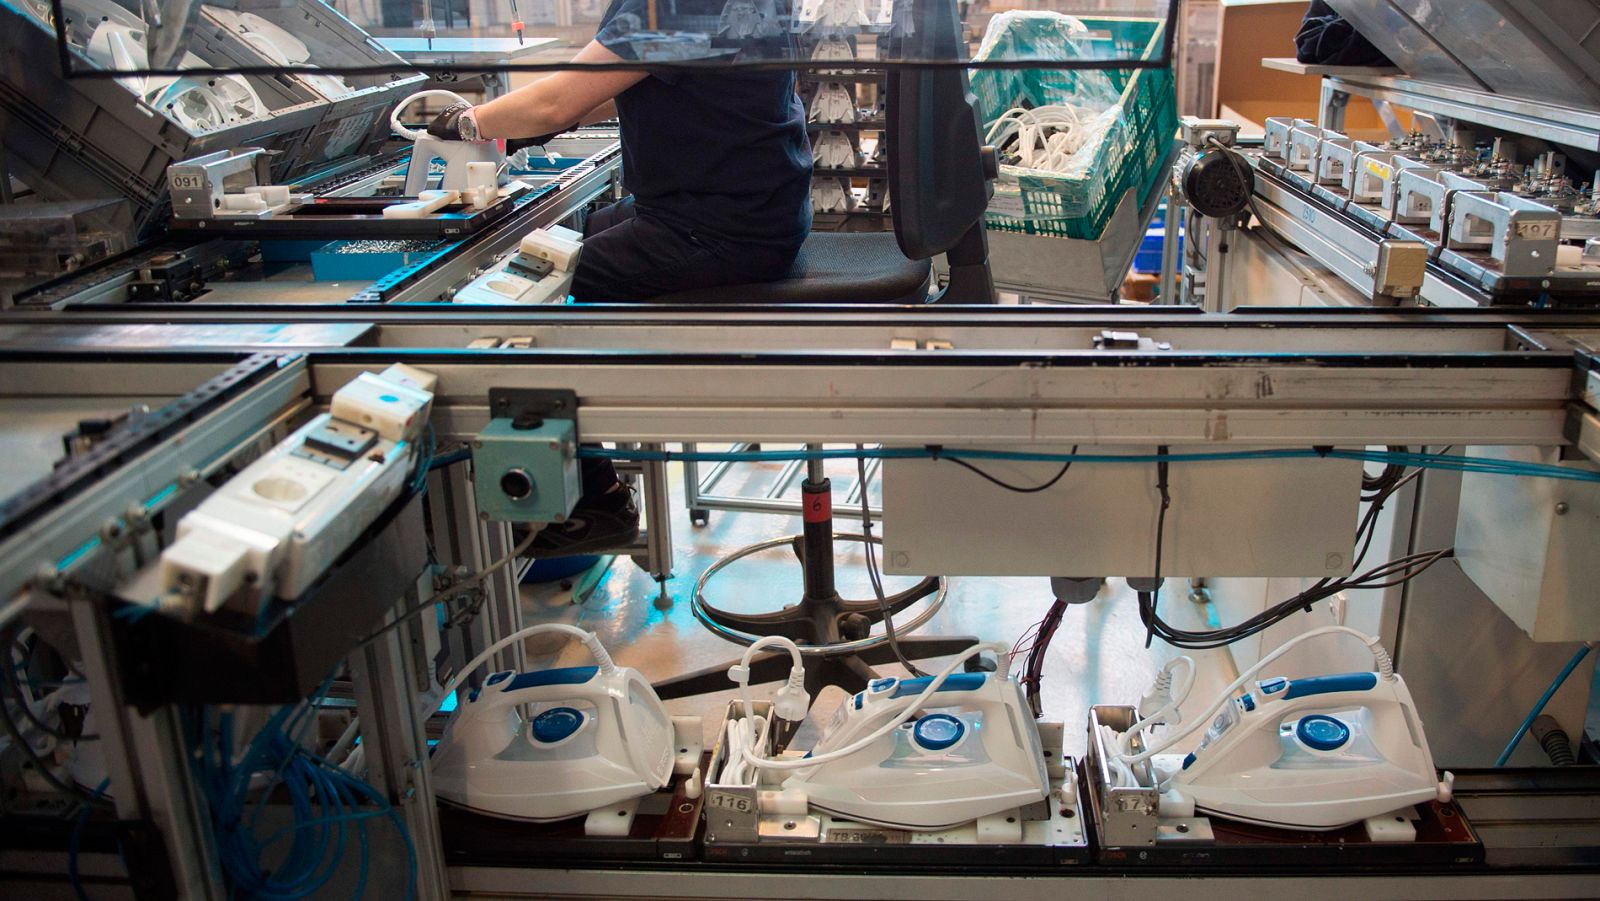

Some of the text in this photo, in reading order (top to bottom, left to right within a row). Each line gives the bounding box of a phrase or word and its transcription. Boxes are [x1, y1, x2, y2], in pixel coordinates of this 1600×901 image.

[174, 176, 199, 188] 091
[812, 496, 822, 512] 6
[715, 795, 748, 811] 116
